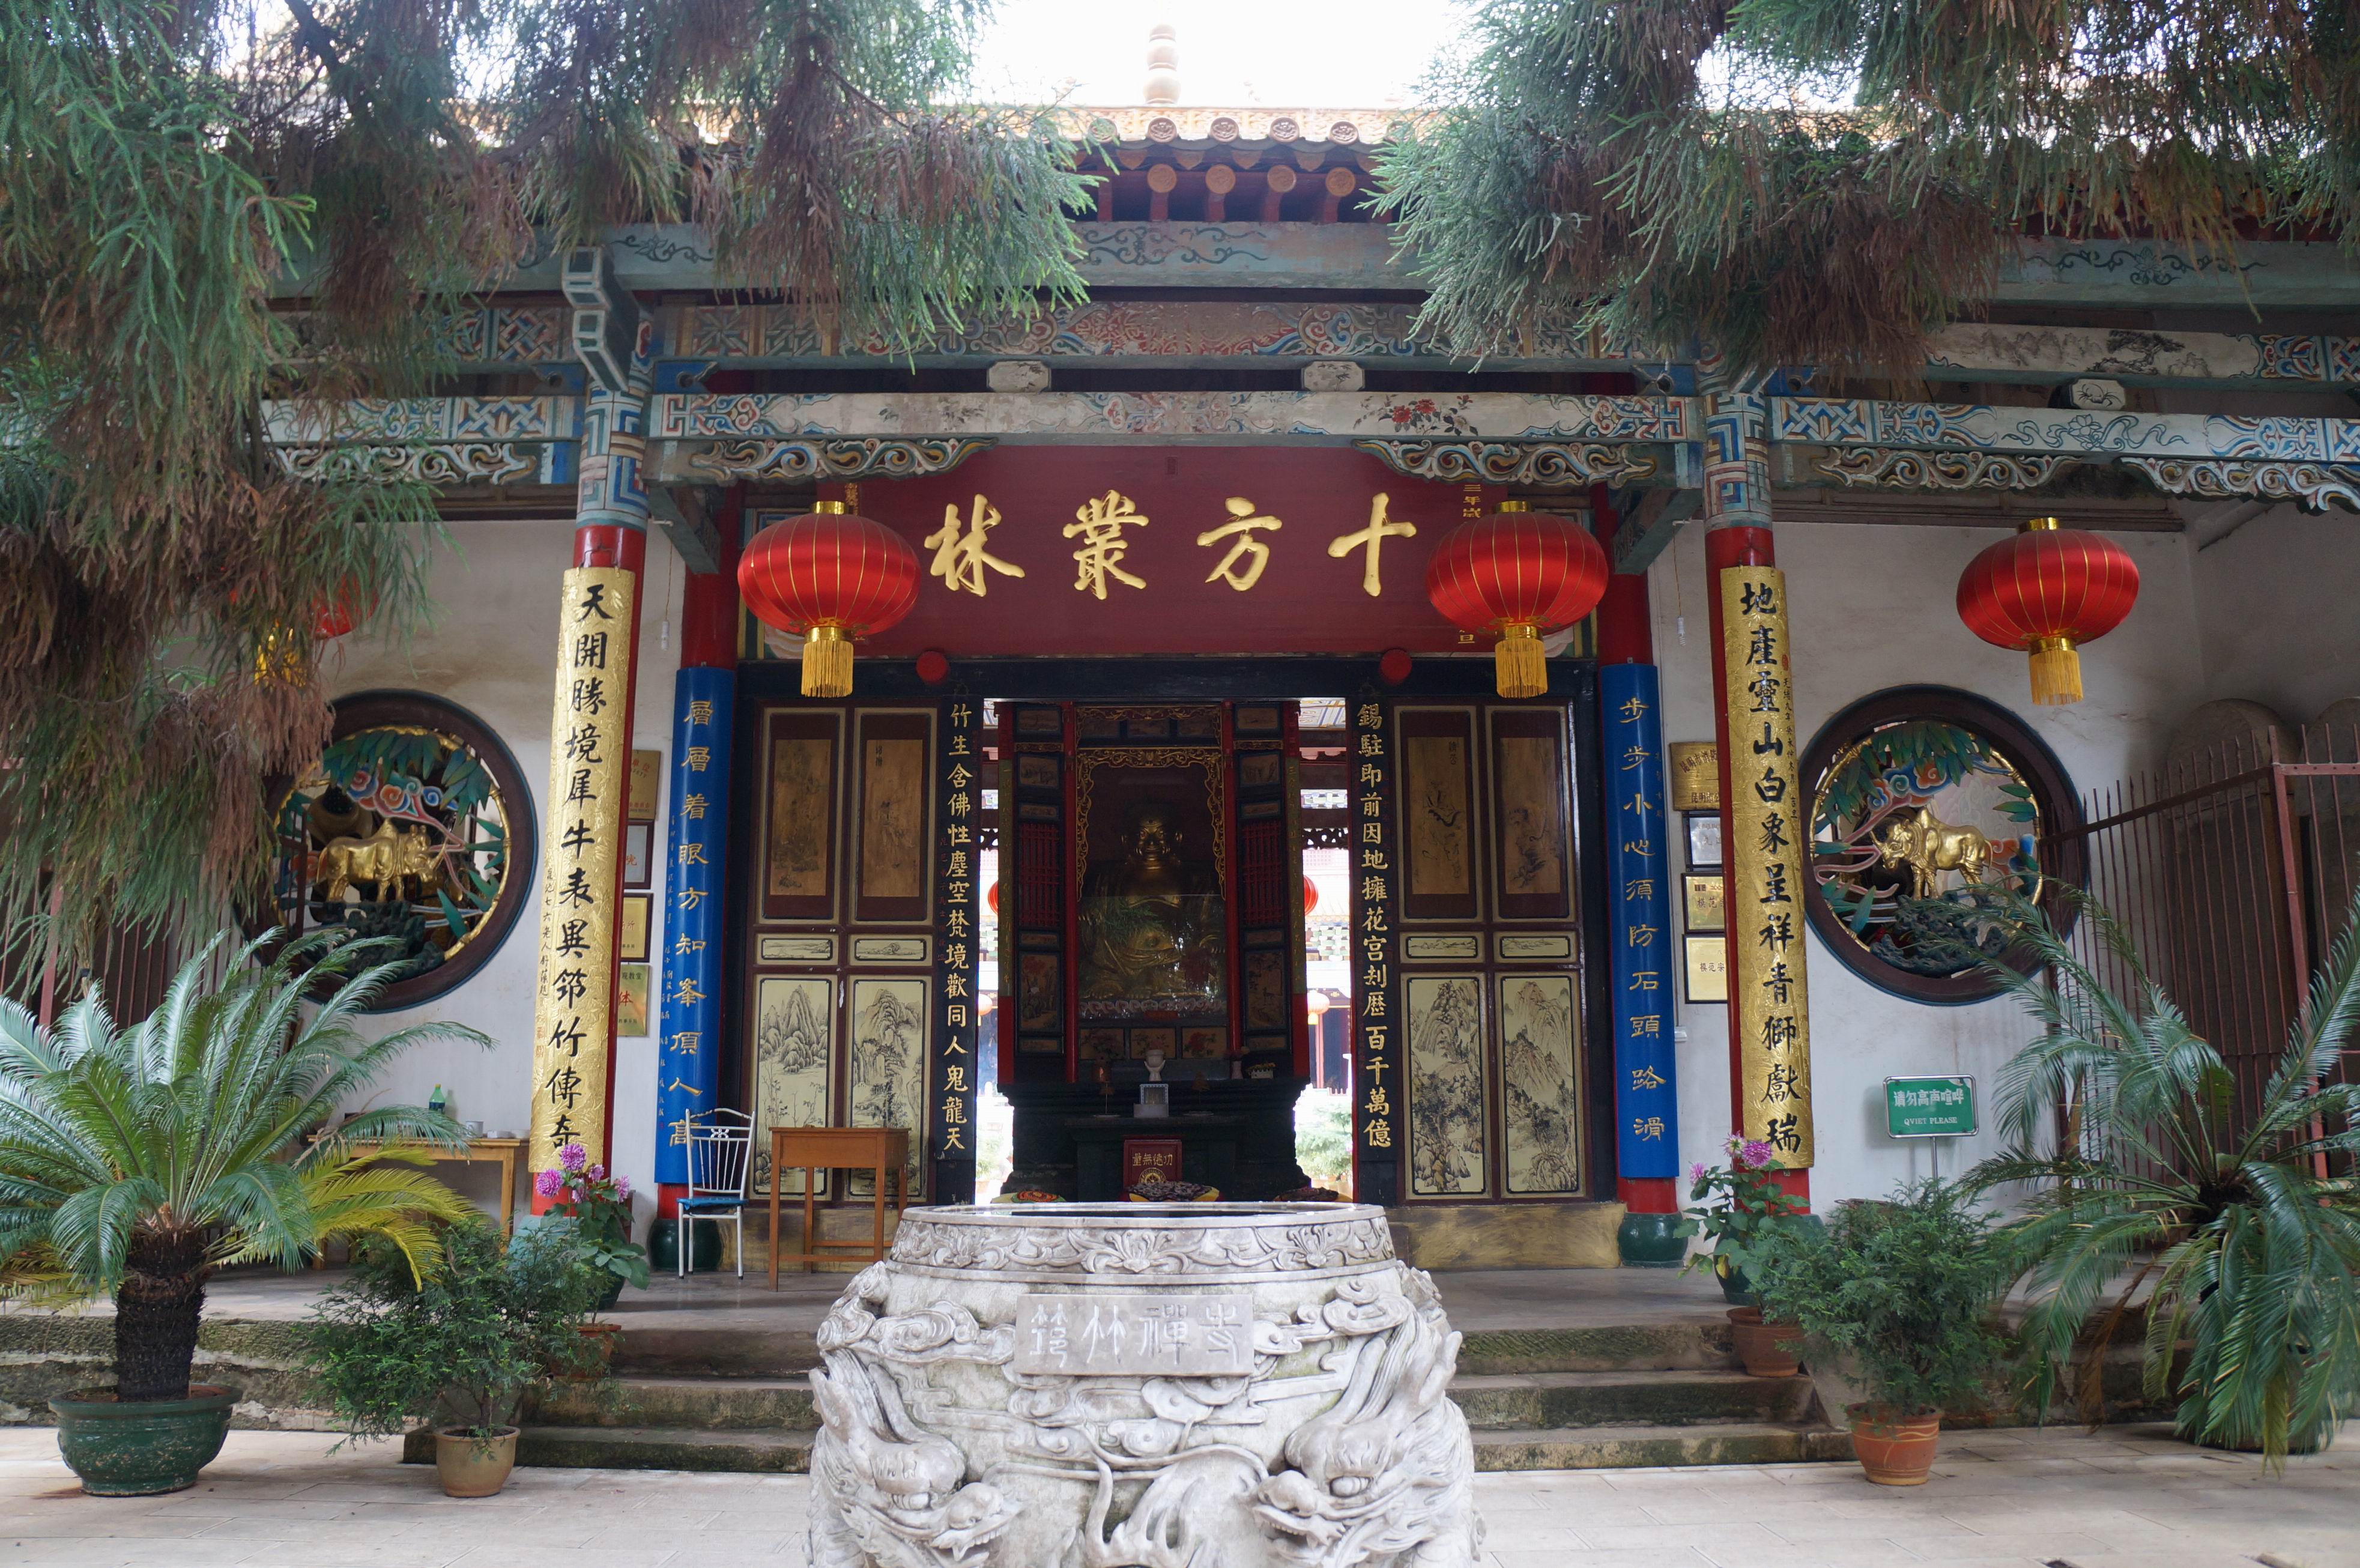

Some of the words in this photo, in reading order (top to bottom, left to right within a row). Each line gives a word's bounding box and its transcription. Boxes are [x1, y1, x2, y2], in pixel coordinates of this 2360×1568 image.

[1893, 1088, 1964, 1107] 请勿高声喧哗
